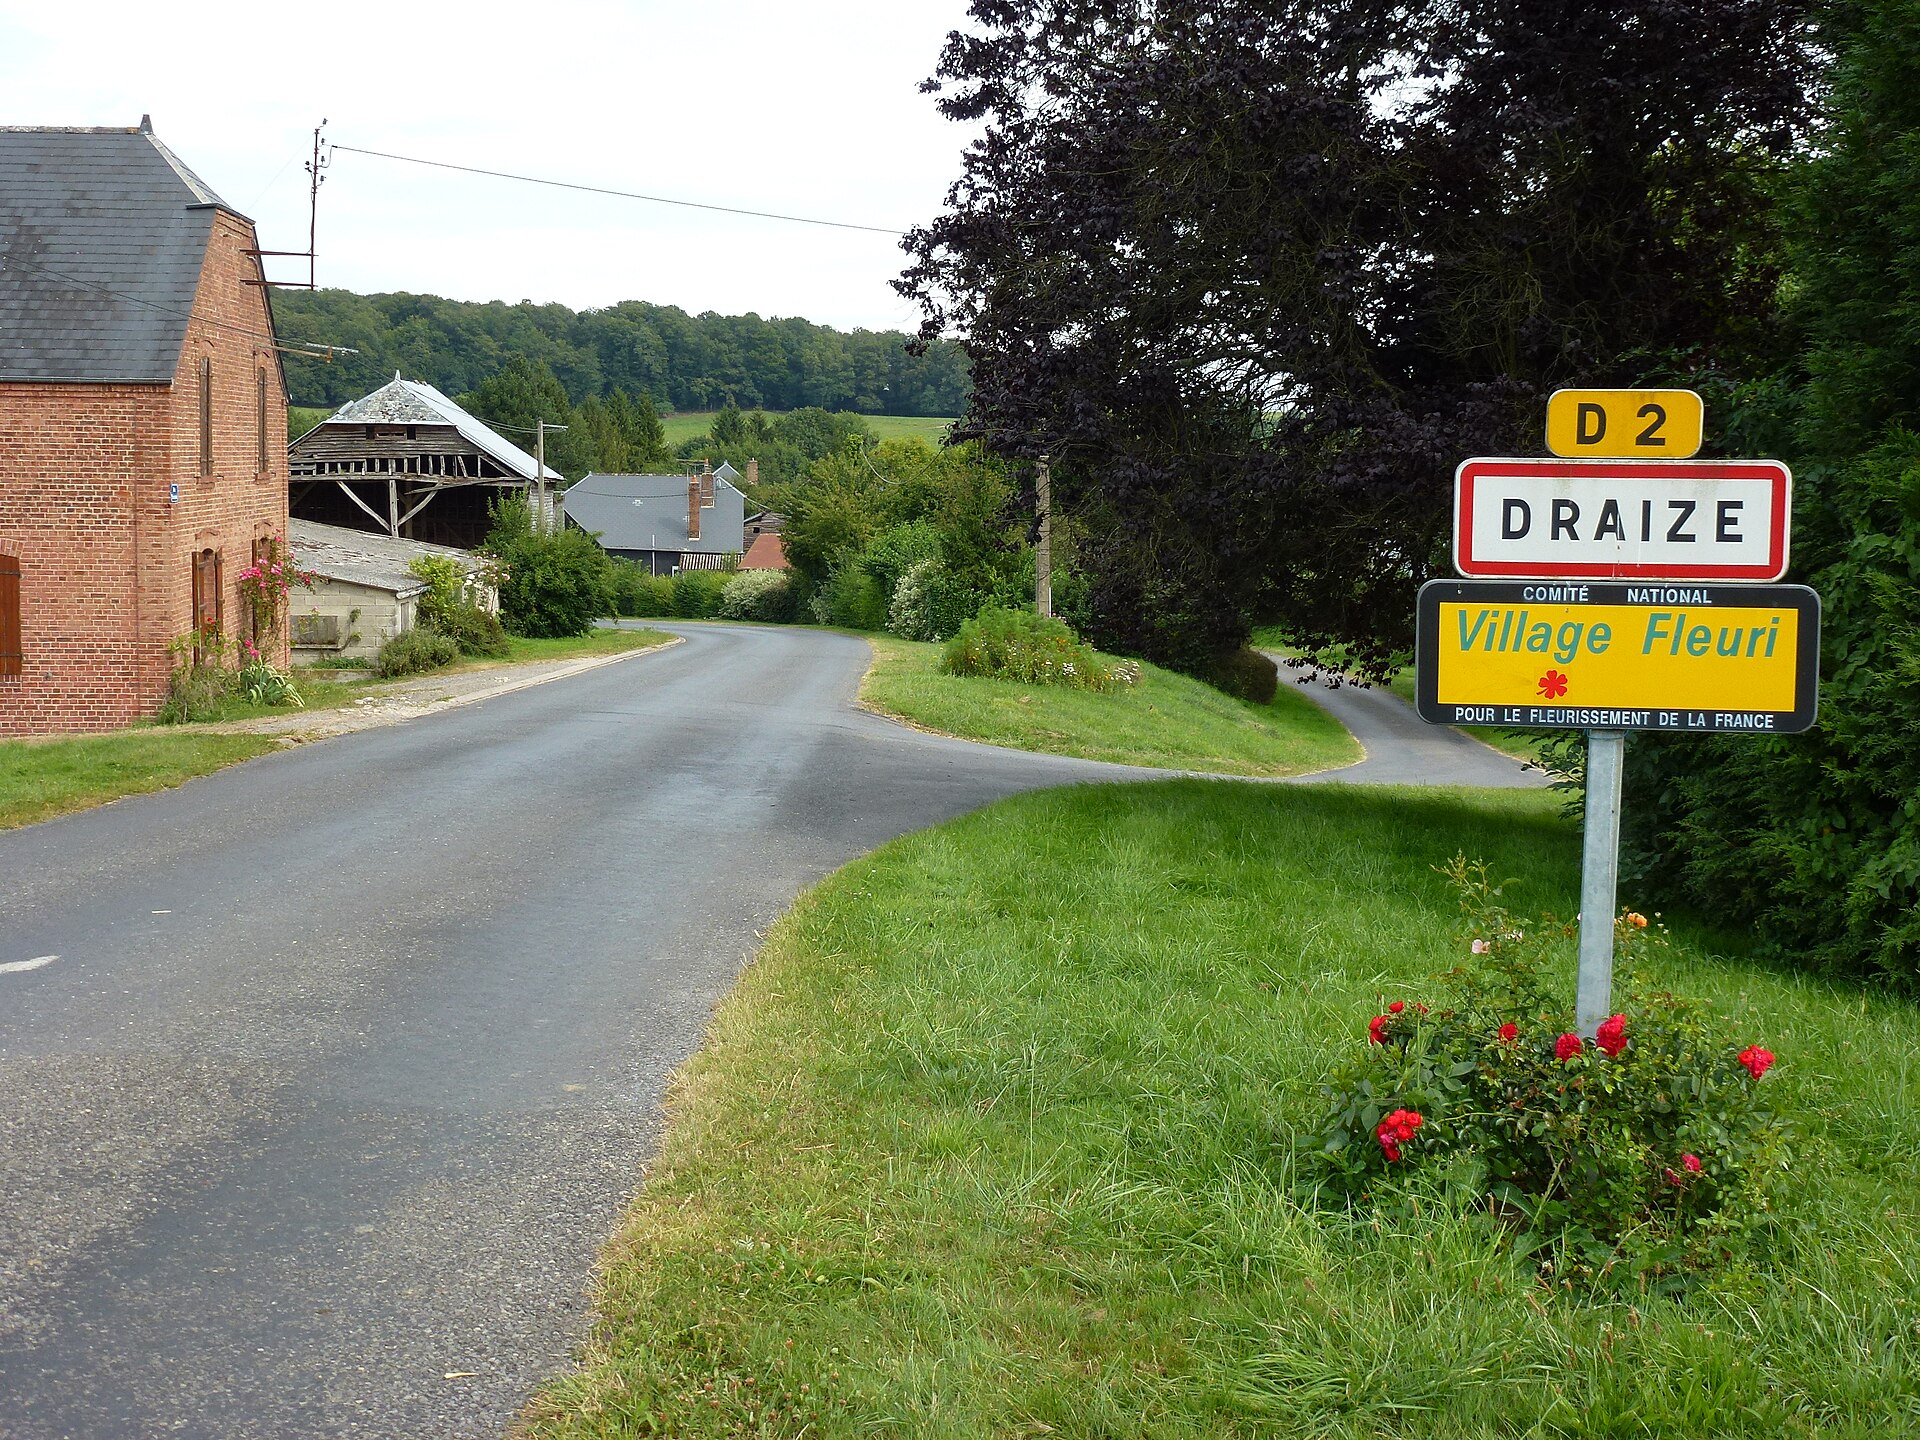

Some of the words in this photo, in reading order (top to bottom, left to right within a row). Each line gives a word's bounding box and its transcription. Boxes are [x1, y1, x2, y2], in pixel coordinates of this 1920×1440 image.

[1576, 402, 1607, 445] D
[1635, 403, 1667, 446] 2
[1501, 498, 1744, 543] DRAIZE
[1523, 584, 1589, 602] COMITÉ
[1627, 588, 1712, 604] NATIONAL
[1457, 609, 1612, 665] Village
[1642, 612, 1781, 658] Fleuri
[1455, 706, 1495, 722] POUR
[1504, 708, 1521, 723] LE
[1529, 709, 1650, 726] FLEURISSEMENT
[1659, 711, 1679, 726] DE
[1687, 712, 1706, 727] LA
[1715, 713, 1774, 729] FRANCE
